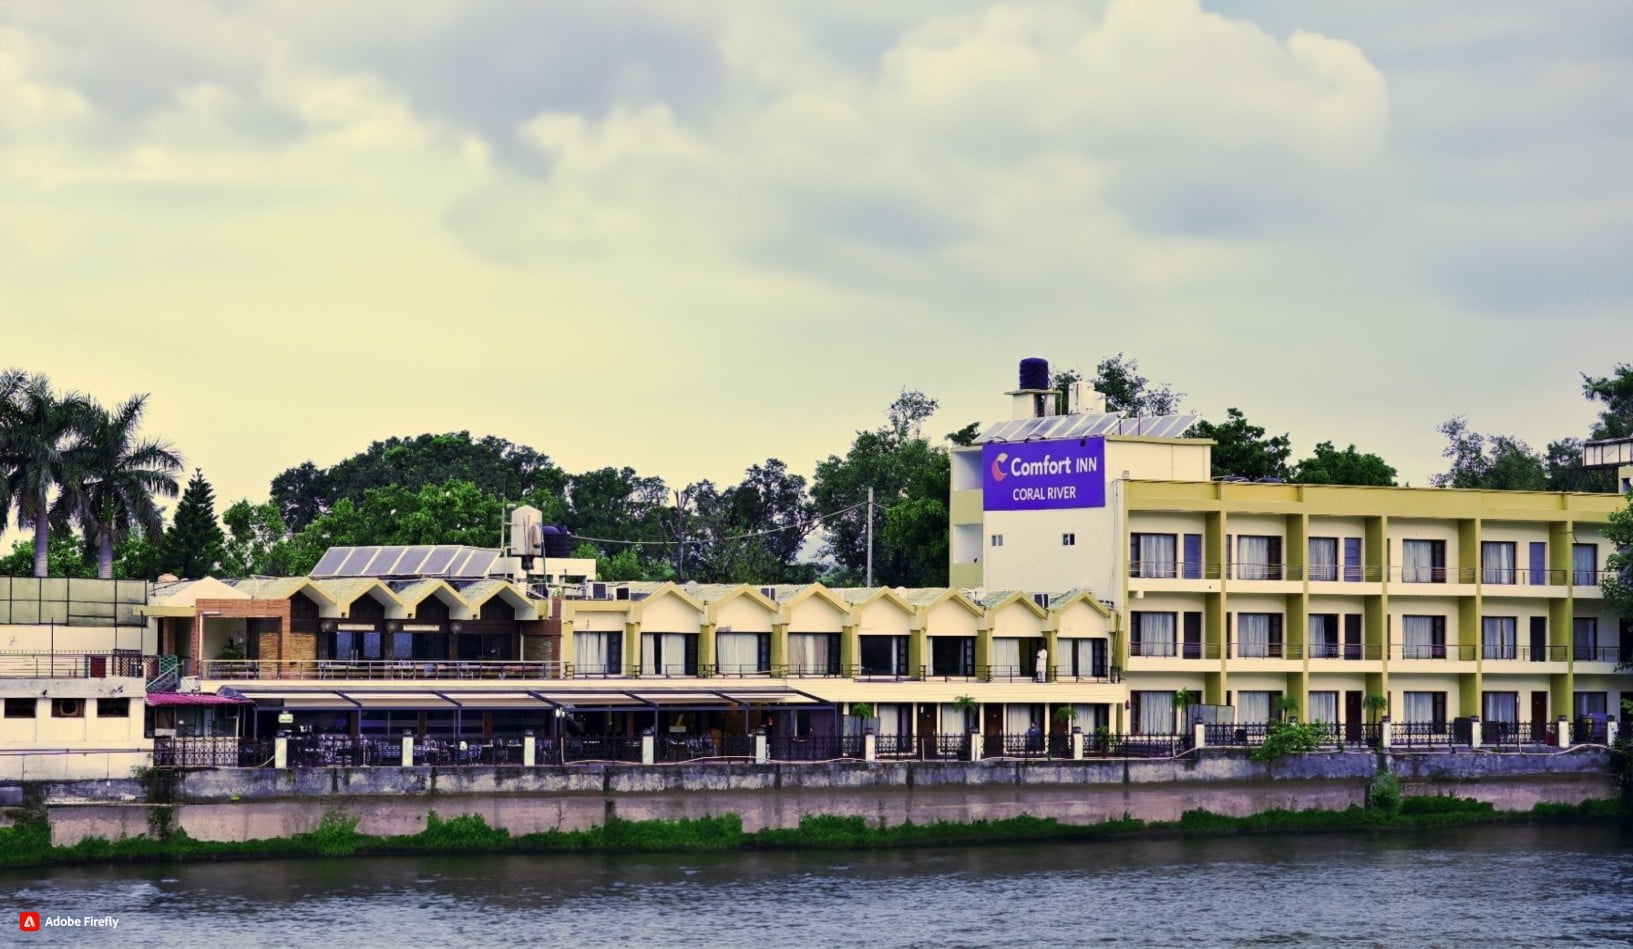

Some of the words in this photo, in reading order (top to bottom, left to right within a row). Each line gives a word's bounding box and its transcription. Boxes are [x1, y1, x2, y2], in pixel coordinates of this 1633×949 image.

[1011, 455, 1071, 476] Comfort
[1076, 457, 1097, 473] INN
[1013, 488, 1045, 501] CORAL
[1048, 486, 1076, 500] RIVER
